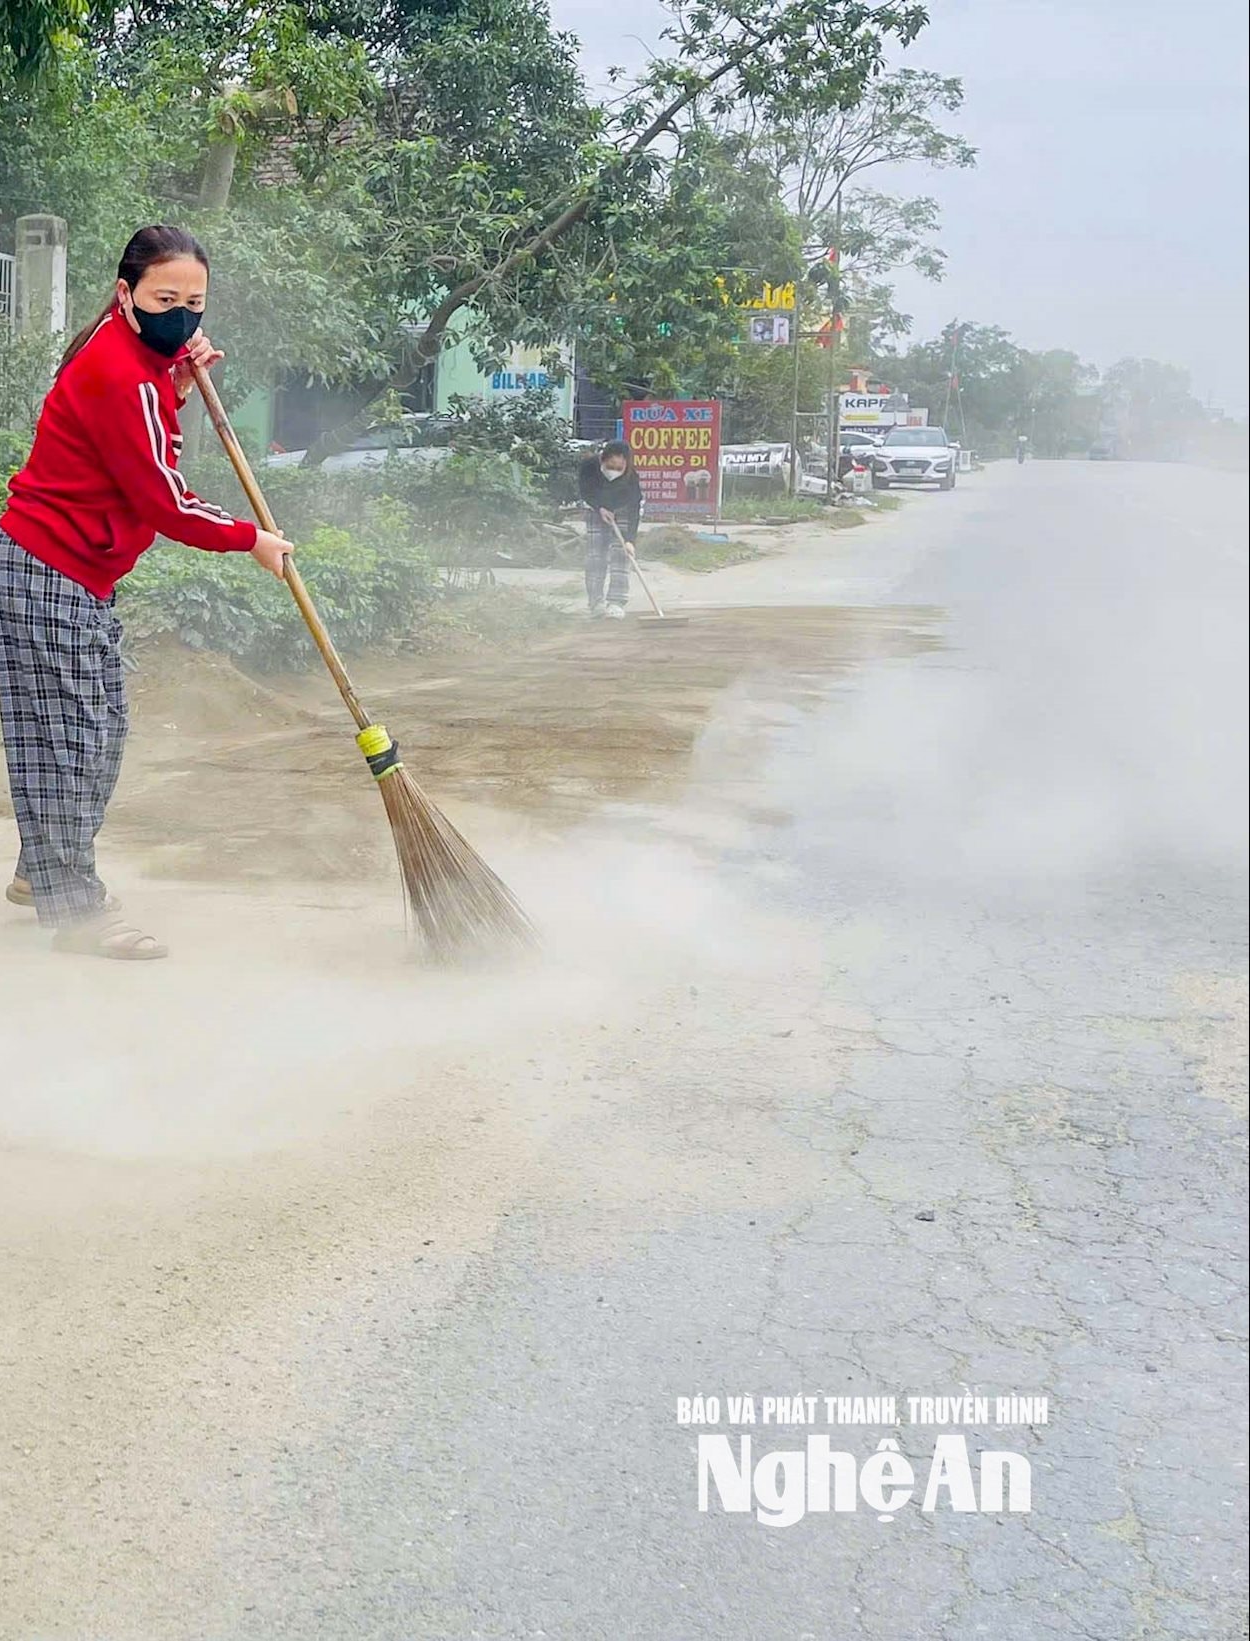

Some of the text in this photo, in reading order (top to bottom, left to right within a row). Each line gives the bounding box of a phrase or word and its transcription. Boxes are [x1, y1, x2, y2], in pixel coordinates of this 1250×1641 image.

[684, 407, 713, 422] XE
[630, 428, 712, 450] COFFEE
[634, 455, 707, 467] MANG ĐI
